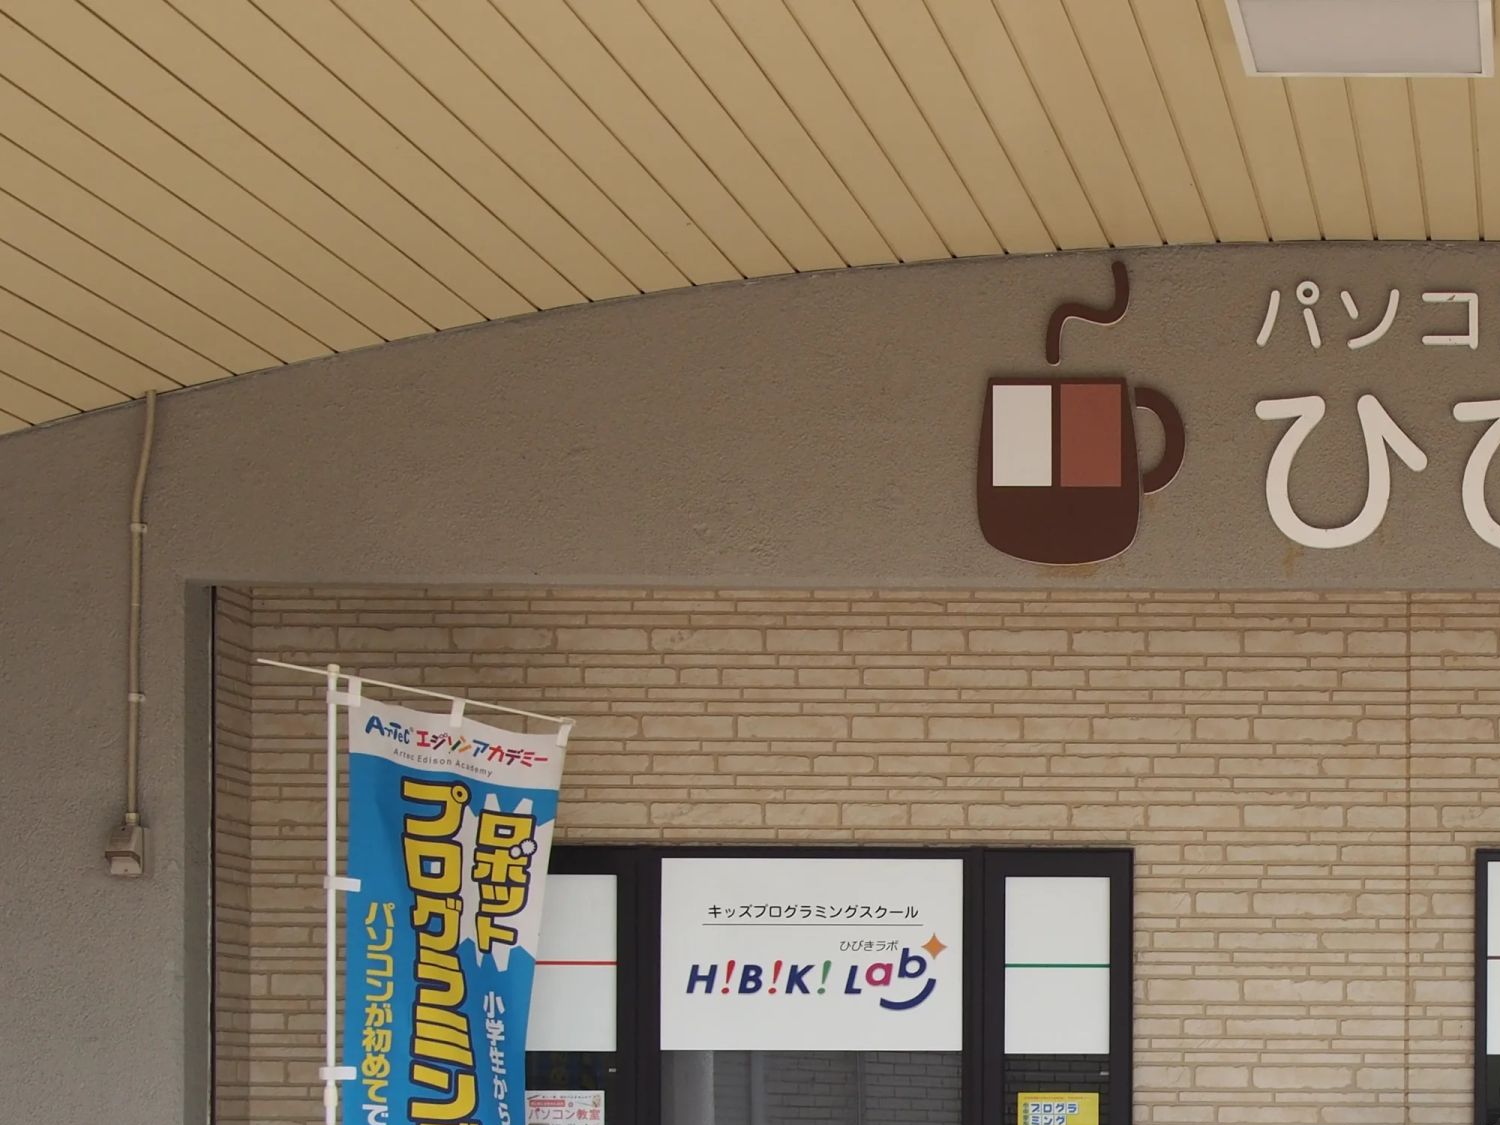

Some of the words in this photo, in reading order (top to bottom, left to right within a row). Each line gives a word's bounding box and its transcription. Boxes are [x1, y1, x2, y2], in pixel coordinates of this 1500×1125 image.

[416, 730, 549, 768] エジソンアカデミー
[393, 748, 416, 762] Artec
[416, 754, 452, 766] Edison
[455, 759, 493, 778] Academy
[471, 809, 538, 953] ロボット
[707, 904, 919, 920] キッズプログラミングスクール
[839, 939, 899, 953] ひびきラボ
[686, 959, 832, 995] H!B!K!
[844, 947, 928, 995] Lab
[528, 1108, 601, 1120] パソコン教室
[1030, 1103, 1077, 1113] プログラ
[1030, 1115, 1066, 1125] ミング
